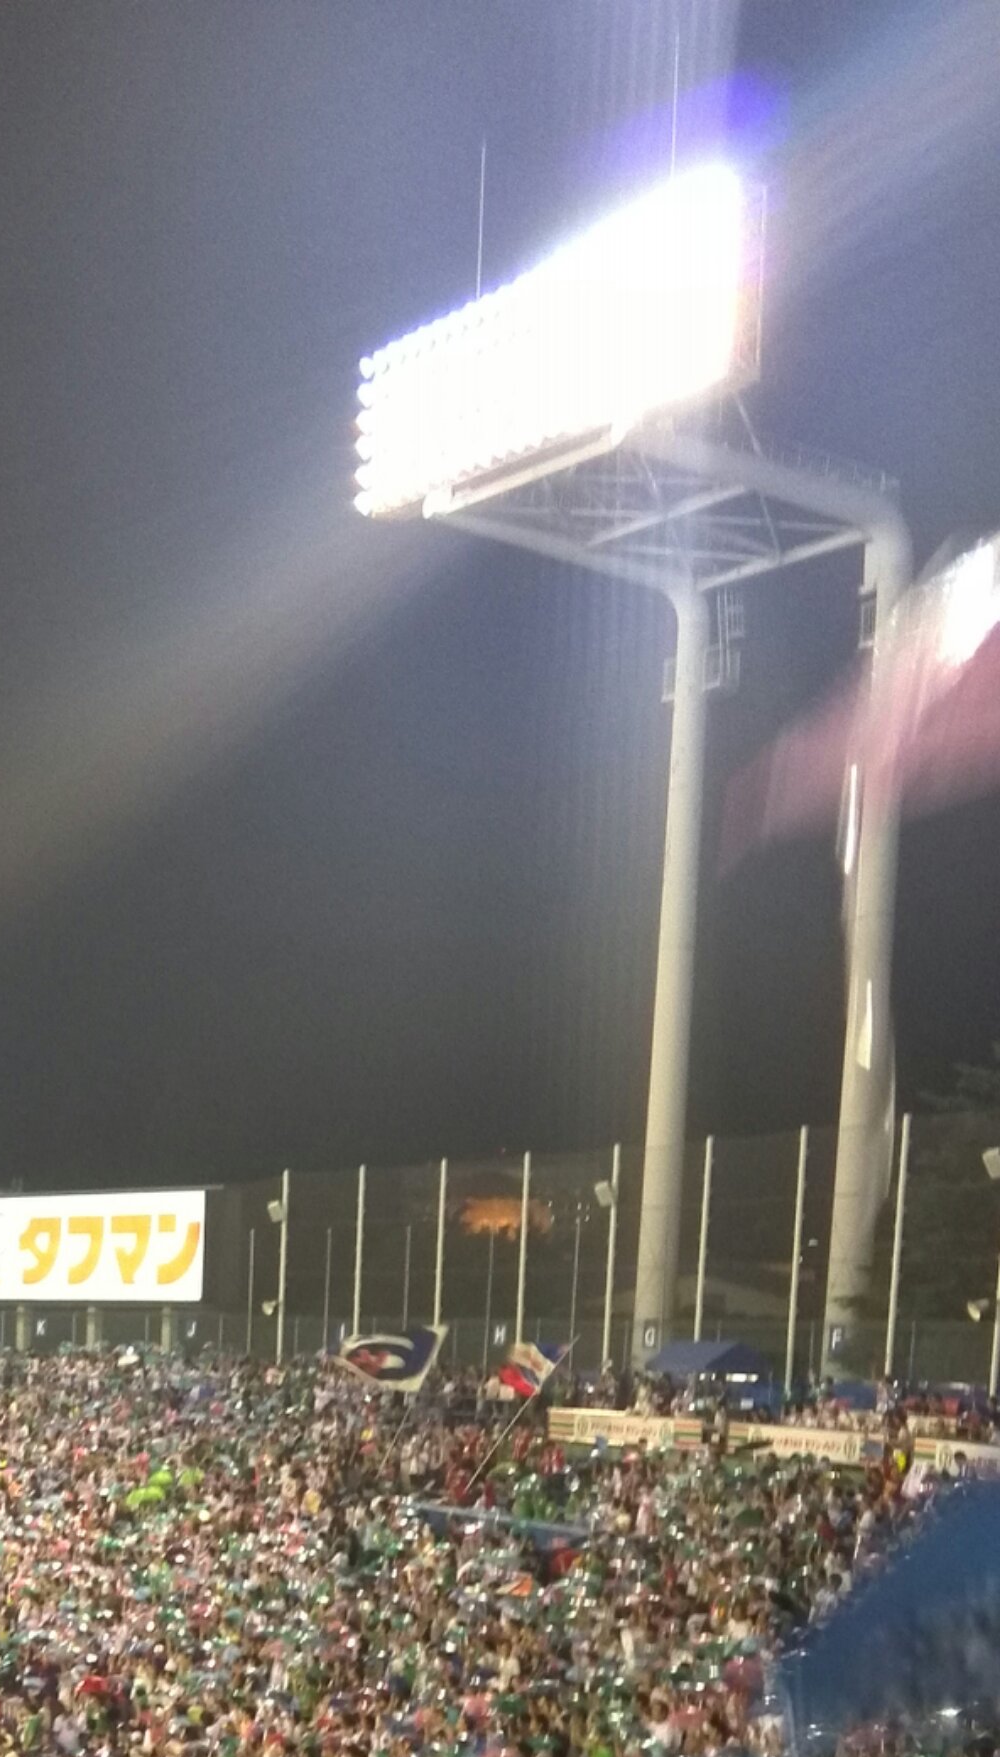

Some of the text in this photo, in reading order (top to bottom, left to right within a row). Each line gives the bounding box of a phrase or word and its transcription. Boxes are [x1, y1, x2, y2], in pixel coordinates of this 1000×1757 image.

[19, 1213, 201, 1285] タフマン
[36, 1319, 46, 1336] K
[494, 1325, 506, 1345] H
